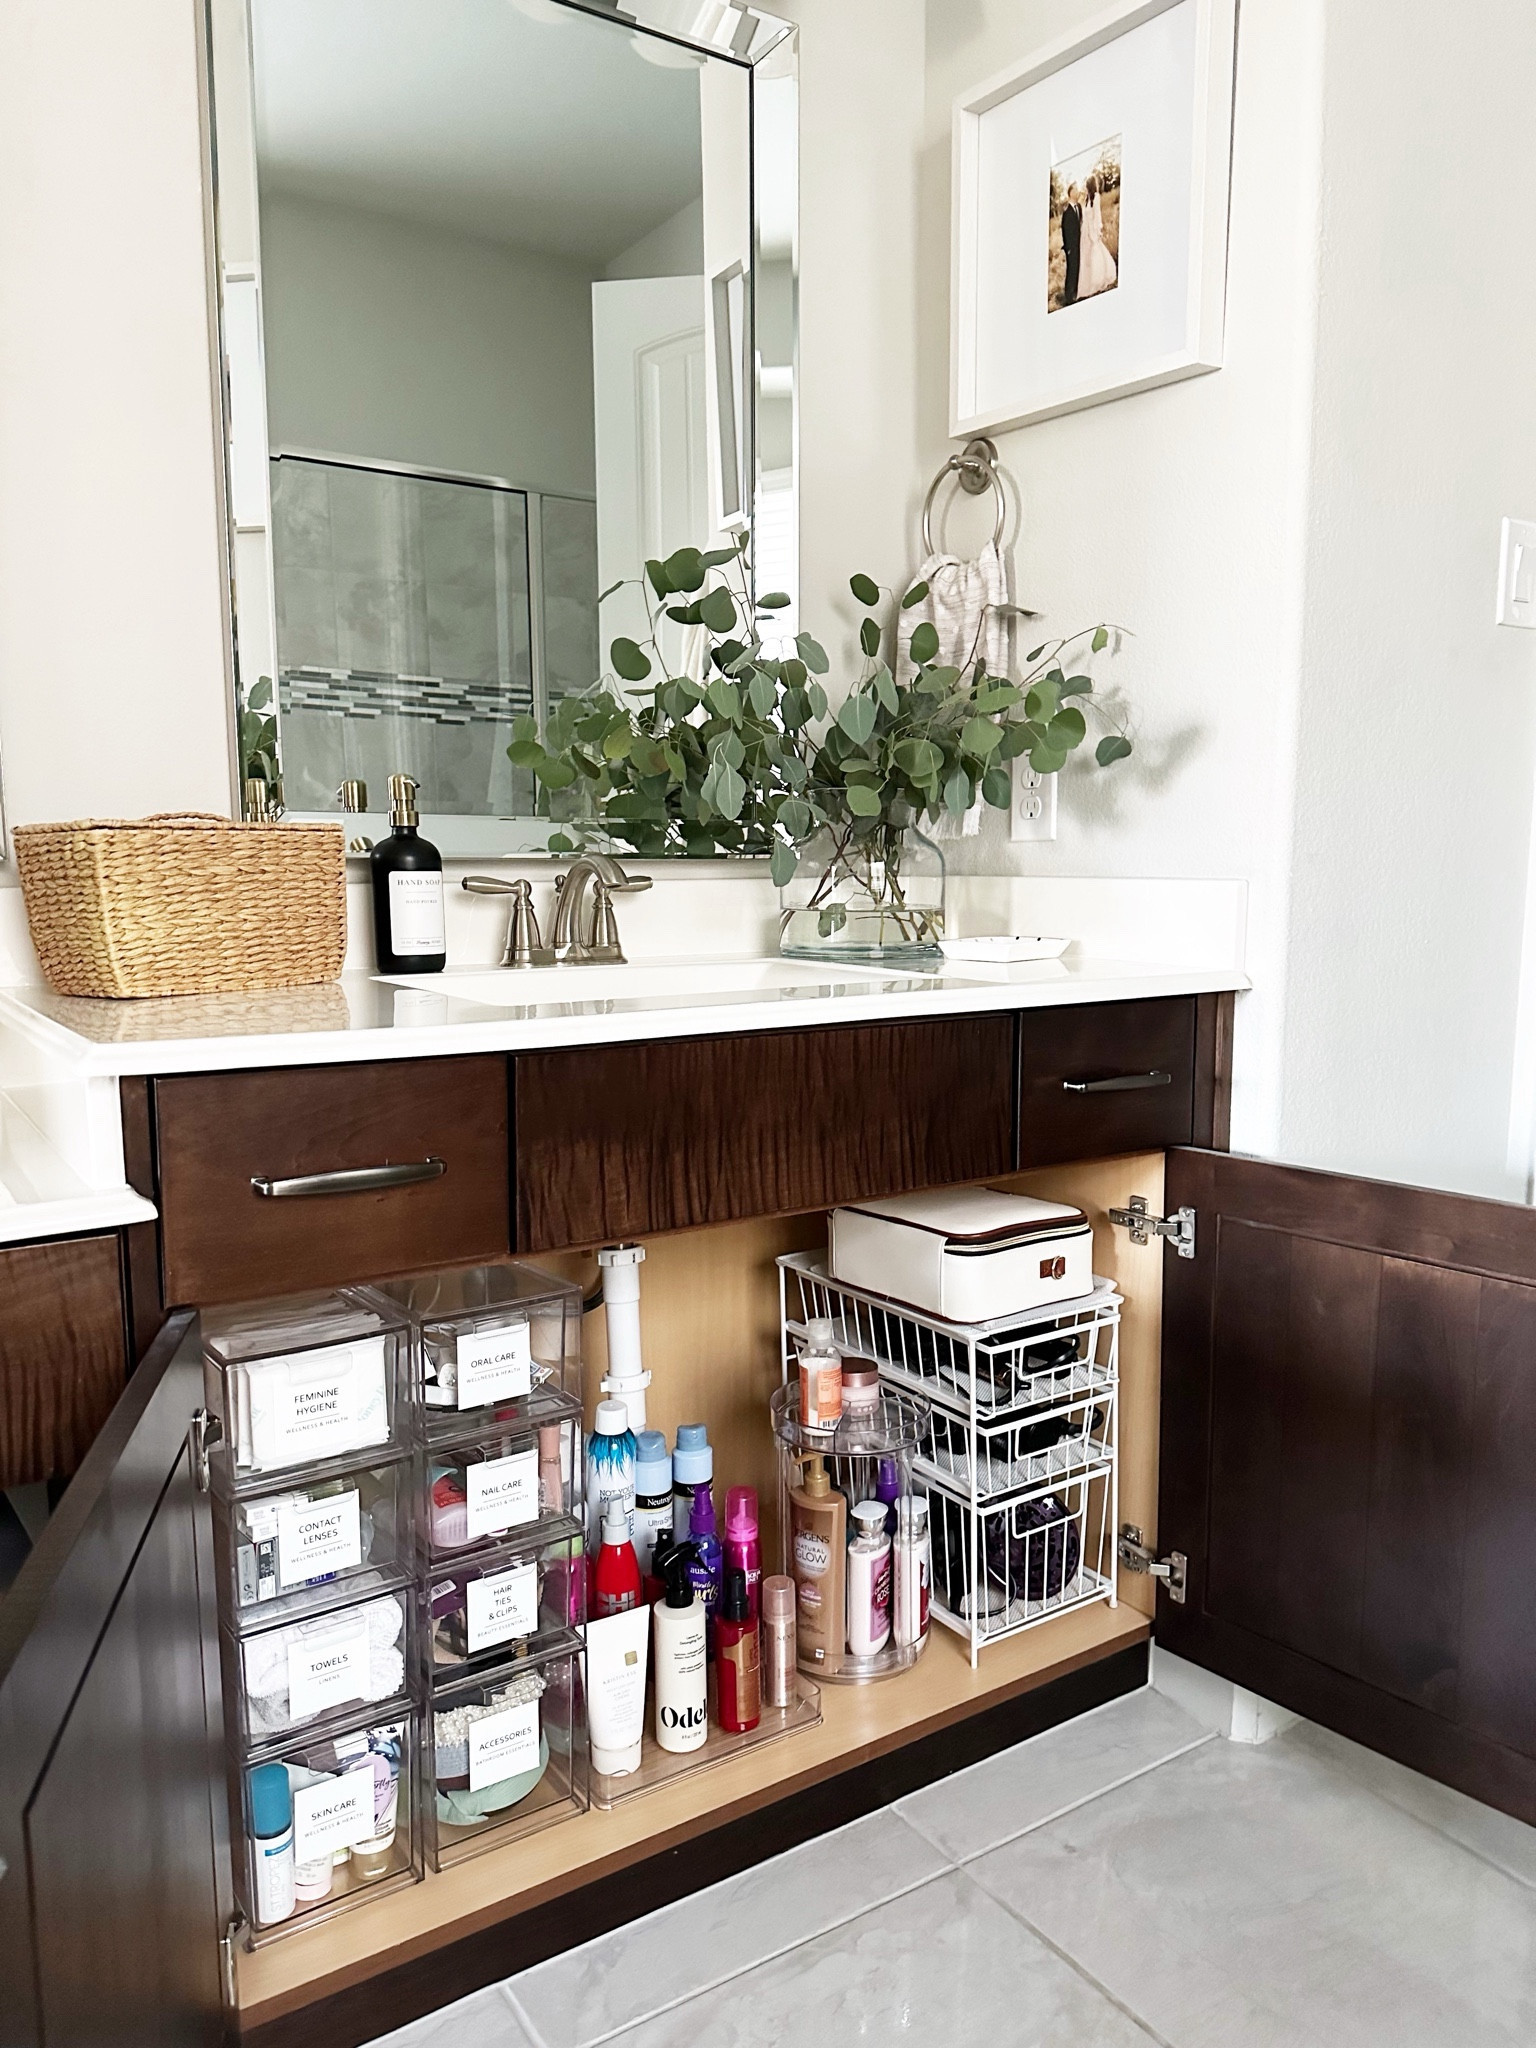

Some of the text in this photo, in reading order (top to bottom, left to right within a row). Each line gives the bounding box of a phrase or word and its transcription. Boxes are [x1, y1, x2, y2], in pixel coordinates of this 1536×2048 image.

[470, 1351, 516, 1368] ORAL CARE
[466, 1373, 495, 1383] WELLNESS
[501, 1367, 521, 1375] HEALTH
[294, 1387, 339, 1404] FEMININE
[296, 1400, 338, 1416] HYGIENE
[286, 1423, 318, 1434] WELLNESS
[325, 1416, 349, 1425] HEALTH
[481, 1479, 522, 1496] NAIL CARE
[298, 1515, 342, 1534] CONTACT
[647, 1518, 663, 1528] Ultra
[303, 1529, 339, 1545] LENSES
[291, 1551, 322, 1563] WELLNESS
[329, 1543, 351, 1553] HEALTH
[795, 1548, 827, 1564] GLOW
[797, 1542, 825, 1553] NATURAL
[493, 1585, 512, 1596] HAIR
[495, 1596, 512, 1606] TIES
[495, 1605, 518, 1618] CLIPS
[310, 1653, 349, 1672] TOWELS
[660, 1698, 707, 1729] Odel
[479, 1726, 532, 1751] ACCESSORIES
[311, 1807, 332, 1821] SKIN
[333, 1797, 357, 1813] CARE
[304, 1823, 335, 1838] WELLNESS
[342, 1812, 364, 1823] HEALTH
